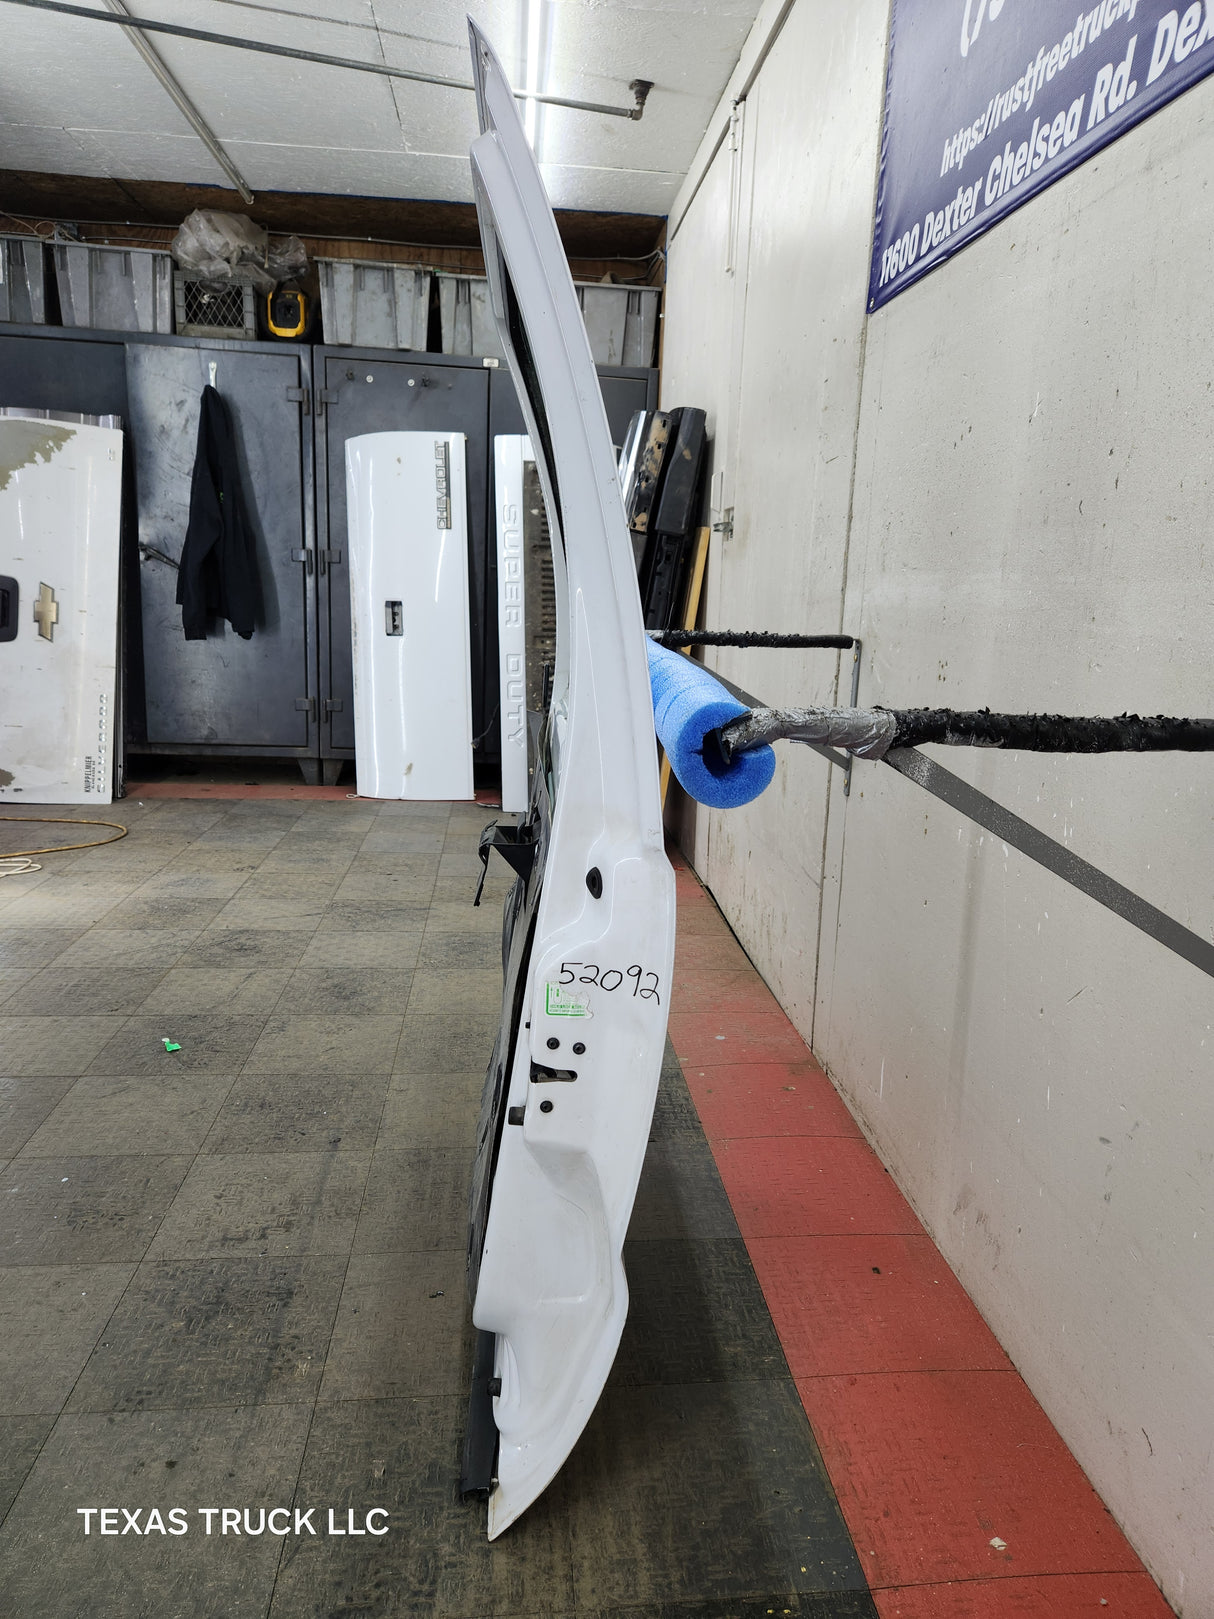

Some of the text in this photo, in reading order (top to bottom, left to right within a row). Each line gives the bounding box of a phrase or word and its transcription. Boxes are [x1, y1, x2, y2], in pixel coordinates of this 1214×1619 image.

[920, 176, 983, 256] Dexter
[984, 93, 1085, 207] Chelsea
[1087, 35, 1138, 130] Rd.
[435, 441, 448, 529] CHEVROLET
[502, 502, 526, 749] SUPER DUTY
[97, 694, 107, 793] SILVERADO
[558, 962, 661, 1006] 52092
